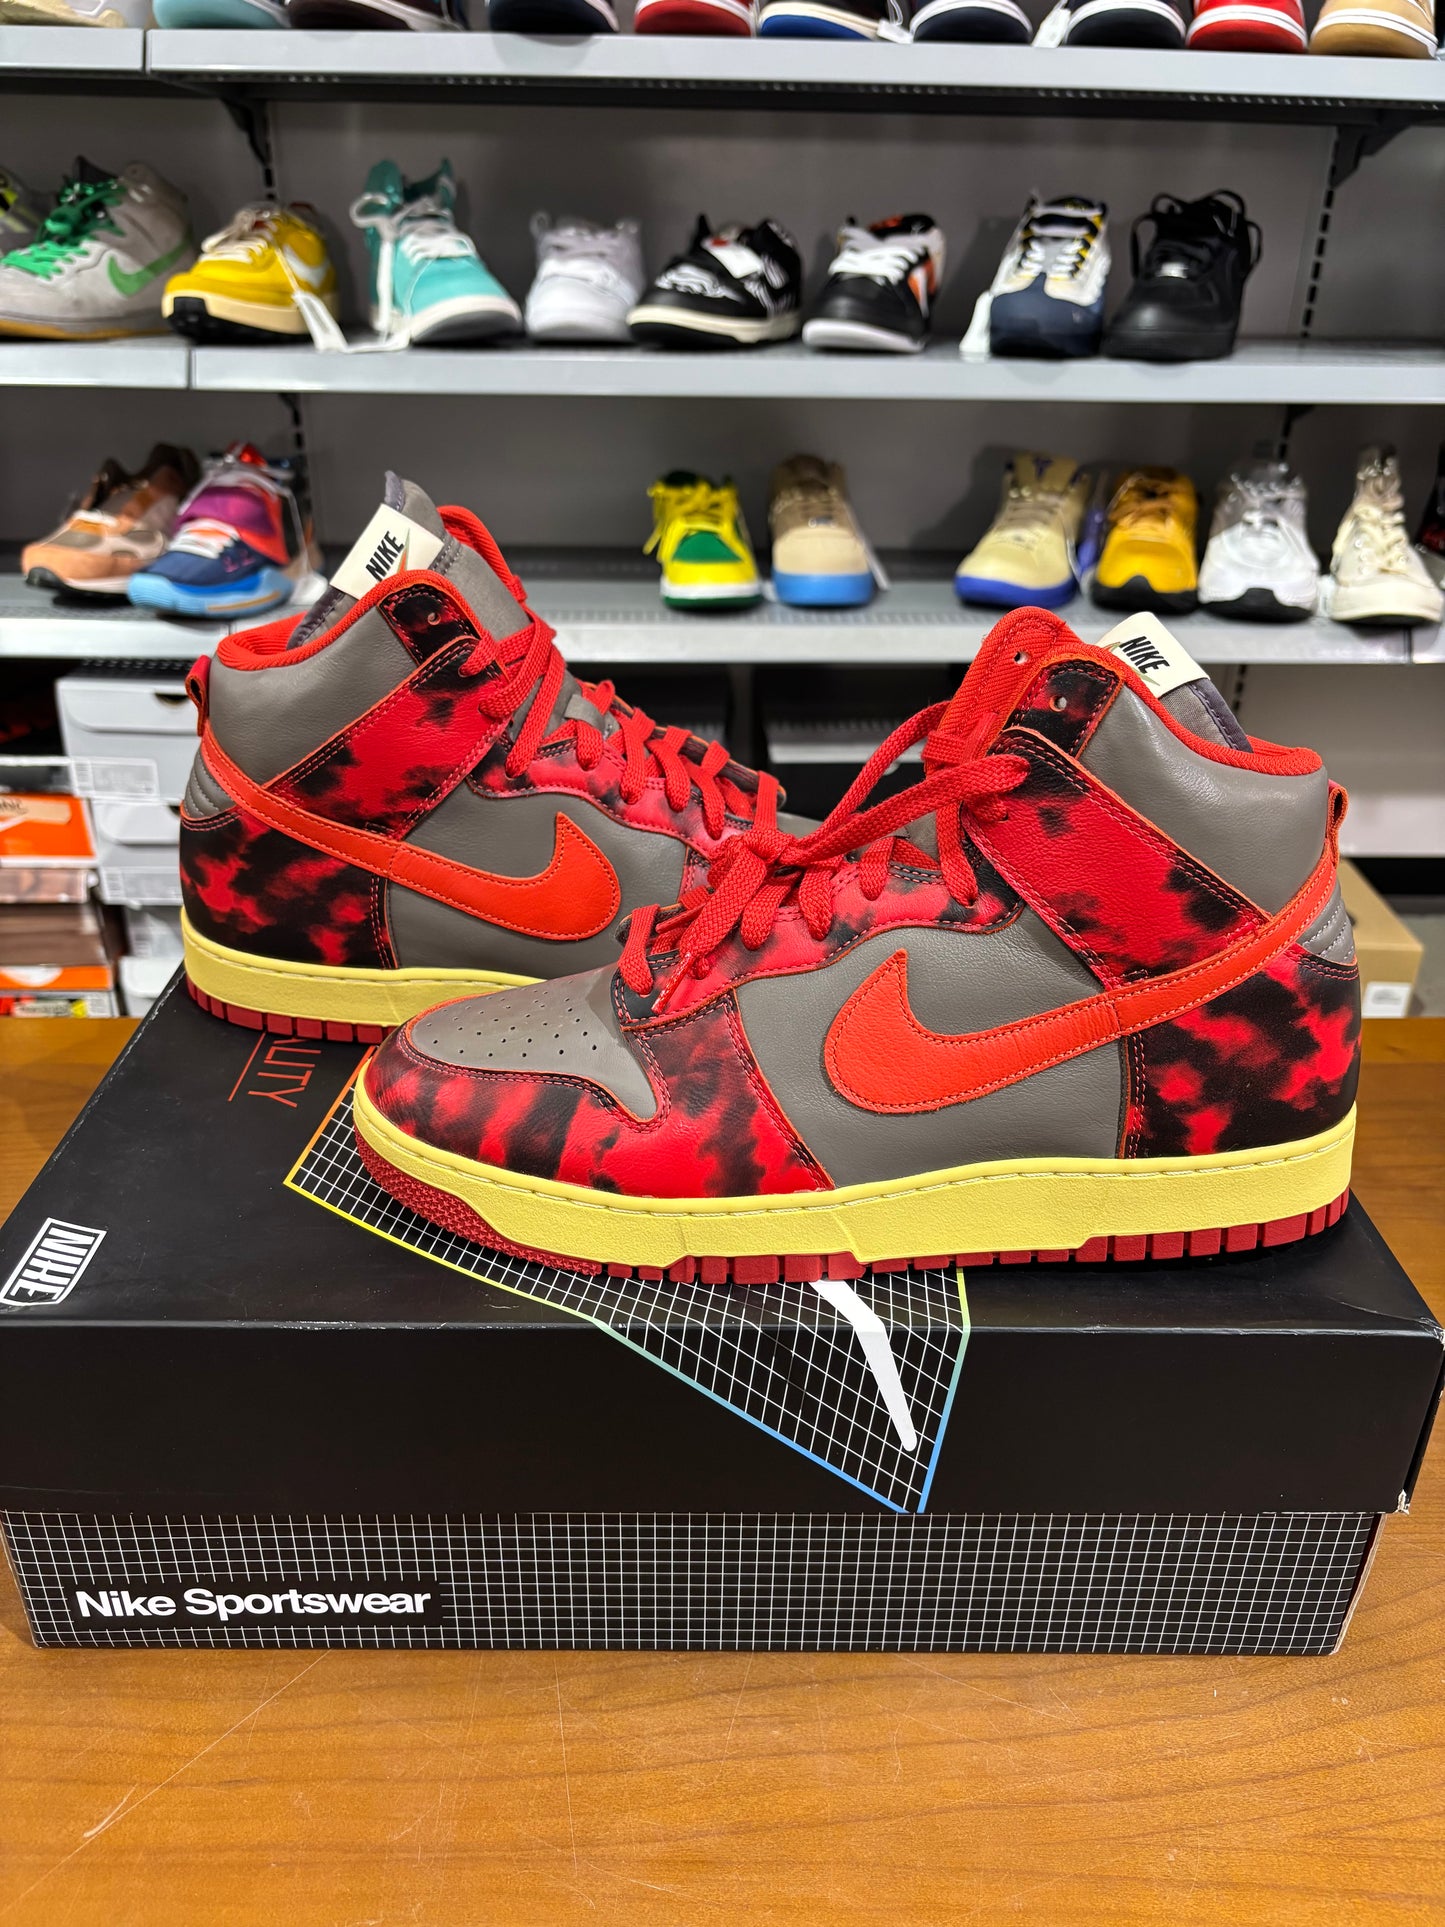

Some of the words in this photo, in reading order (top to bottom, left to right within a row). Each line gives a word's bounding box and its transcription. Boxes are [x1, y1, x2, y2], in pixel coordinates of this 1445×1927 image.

[365, 530, 404, 583] NIKE
[1119, 635, 1170, 674] NIKE
[9, 1226, 96, 1300] NIKE
[75, 1590, 177, 1617] Nike
[183, 1588, 431, 1621] Sportswear
